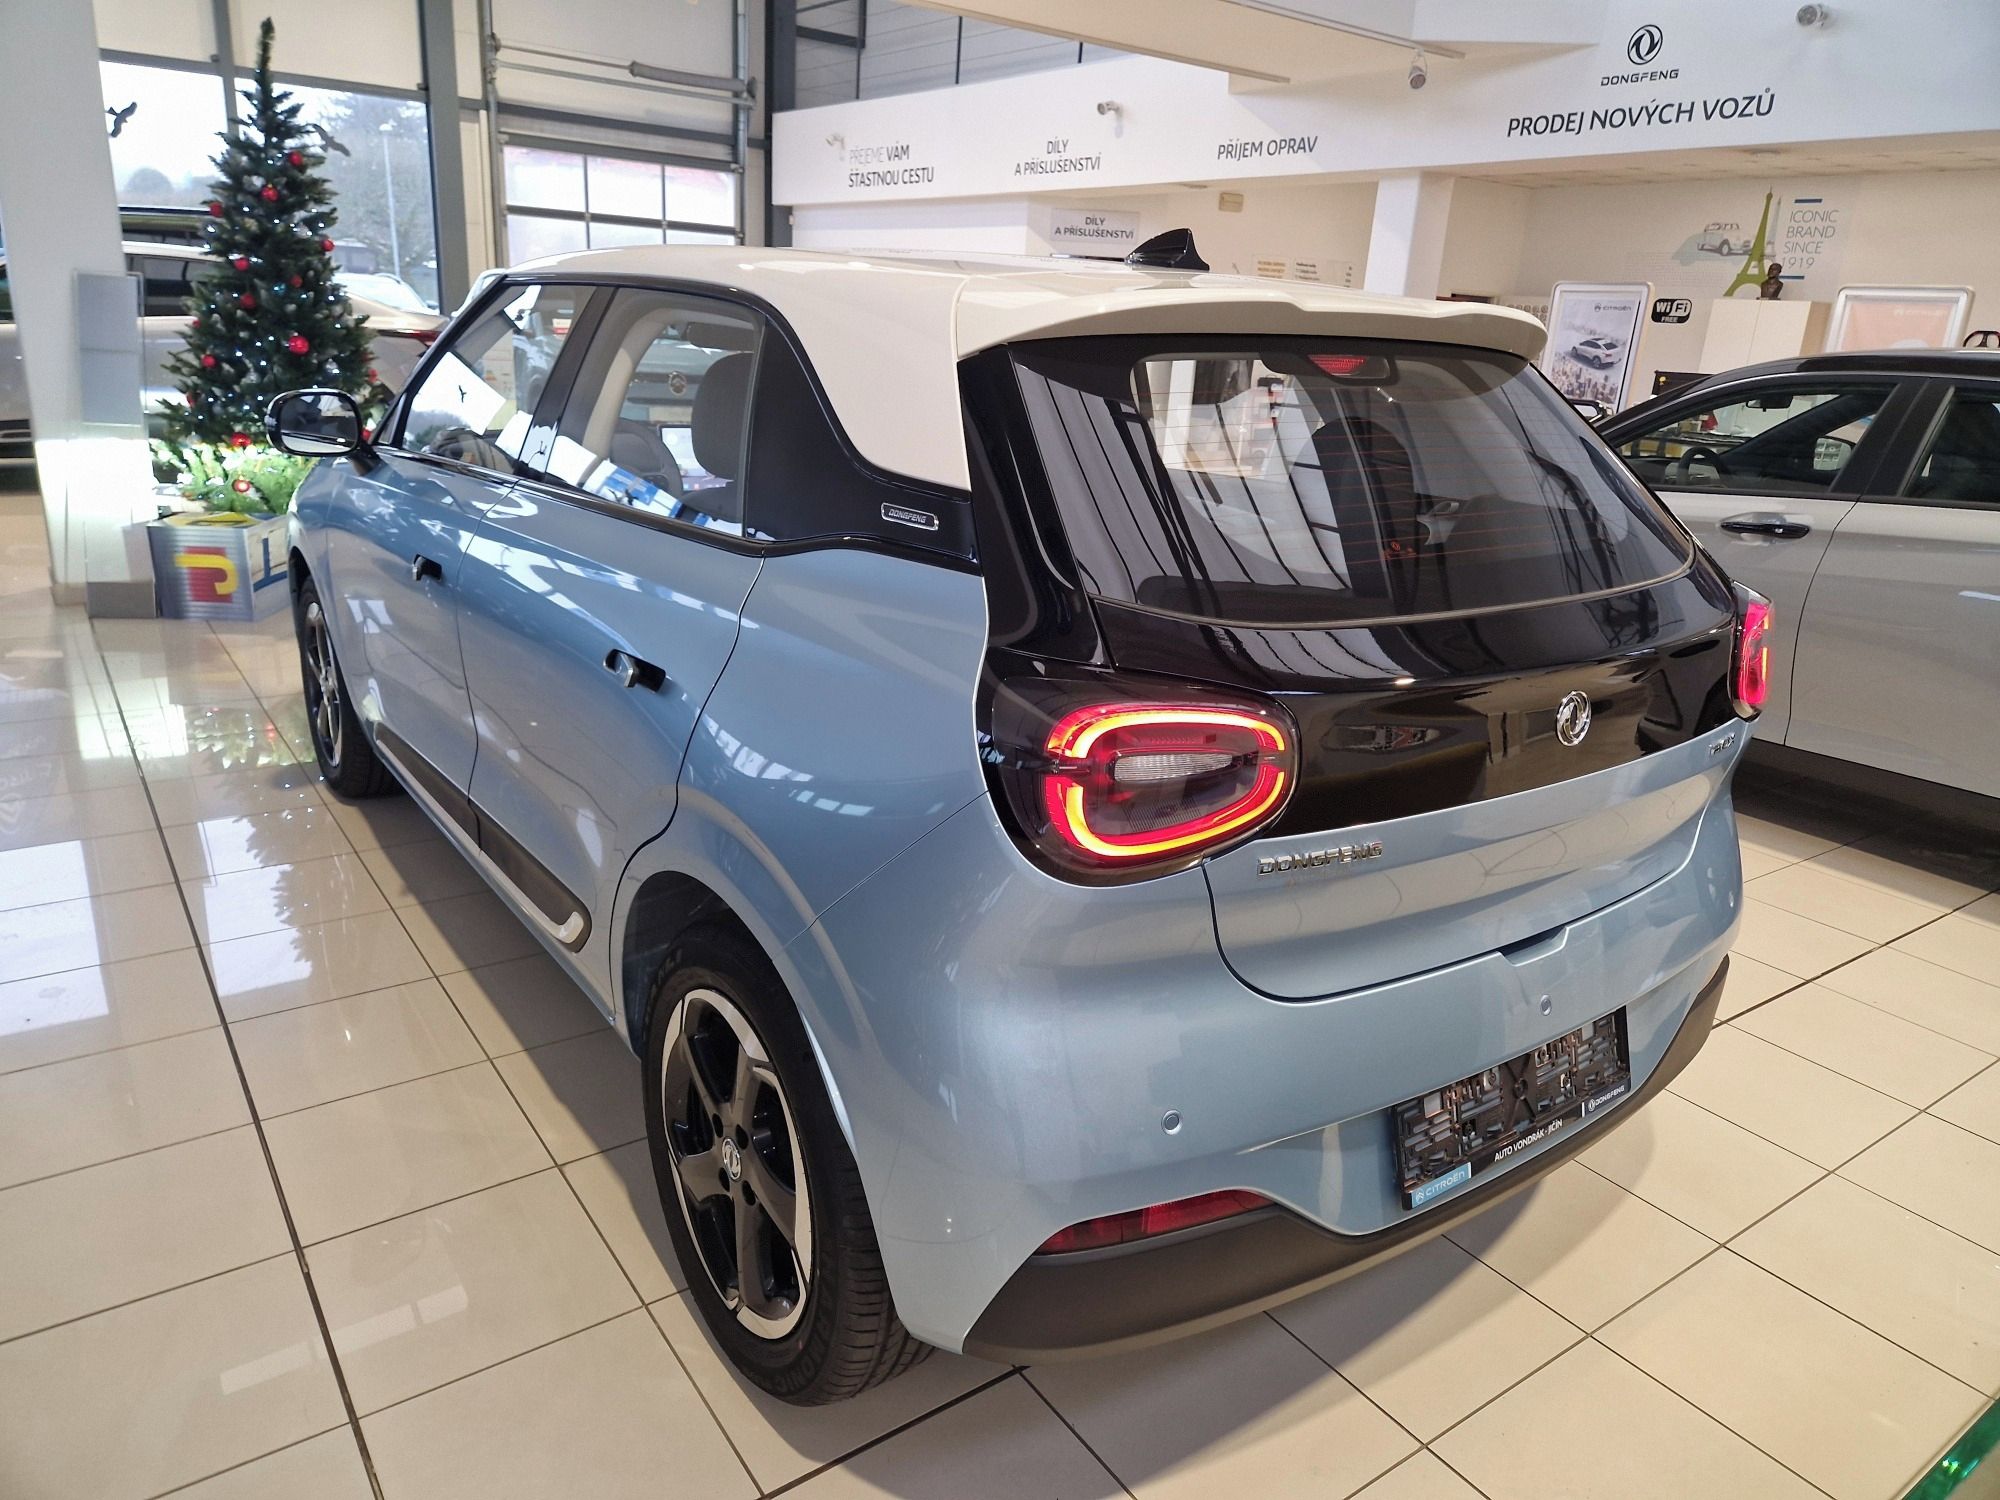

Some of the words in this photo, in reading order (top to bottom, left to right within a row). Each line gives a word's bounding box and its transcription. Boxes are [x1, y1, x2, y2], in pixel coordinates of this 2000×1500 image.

[1600, 69, 1680, 86] DONGFENG
[1507, 111, 1585, 137] PRODEJ
[1589, 98, 1695, 131] NOVÝCH
[1702, 87, 1775, 121] VOZŮ
[886, 140, 910, 161] VÁM
[1046, 136, 1069, 154] DÍLY
[1217, 138, 1263, 161] PŘÍJEM
[1267, 136, 1318, 156] OPRAV
[1014, 162, 1022, 176] A
[1024, 152, 1102, 175] PŘÍSLUŠENSTVÍ
[901, 166, 935, 184] CESTU
[1085, 214, 1106, 226] DÍLY
[1789, 209, 1840, 223] ICONIC
[1054, 227, 1062, 236] A
[1063, 225, 1135, 240] PŘÍSLUŠENSTVÍ
[1786, 225, 1836, 239] BRAND
[1783, 241, 1824, 254] SINCE
[1781, 257, 1815, 269] 1919
[888, 508, 927, 524] DONGFENG
[1257, 840, 1383, 876] DONGFENG
[1595, 1084, 1625, 1106] DONGFENG
[1494, 1145, 1512, 1162] AUTO
[1513, 1128, 1545, 1152] VONDRÁK
